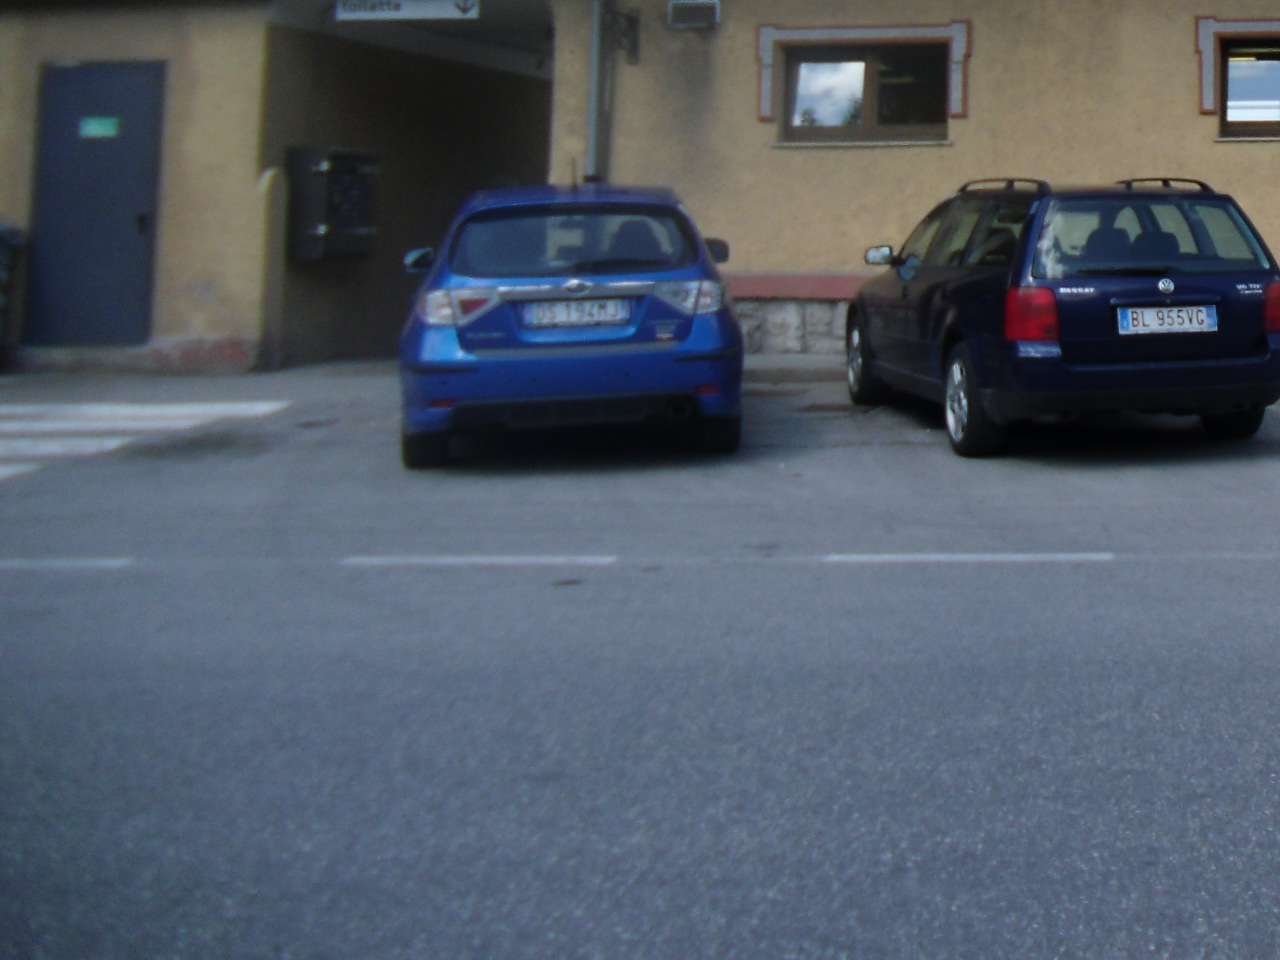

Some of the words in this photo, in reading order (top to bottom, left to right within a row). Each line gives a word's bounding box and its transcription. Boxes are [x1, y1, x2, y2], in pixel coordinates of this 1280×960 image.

[341, 0, 402, 13] toilette
[1130, 310, 1150, 328] BL
[1156, 308, 1206, 327] 955VG
